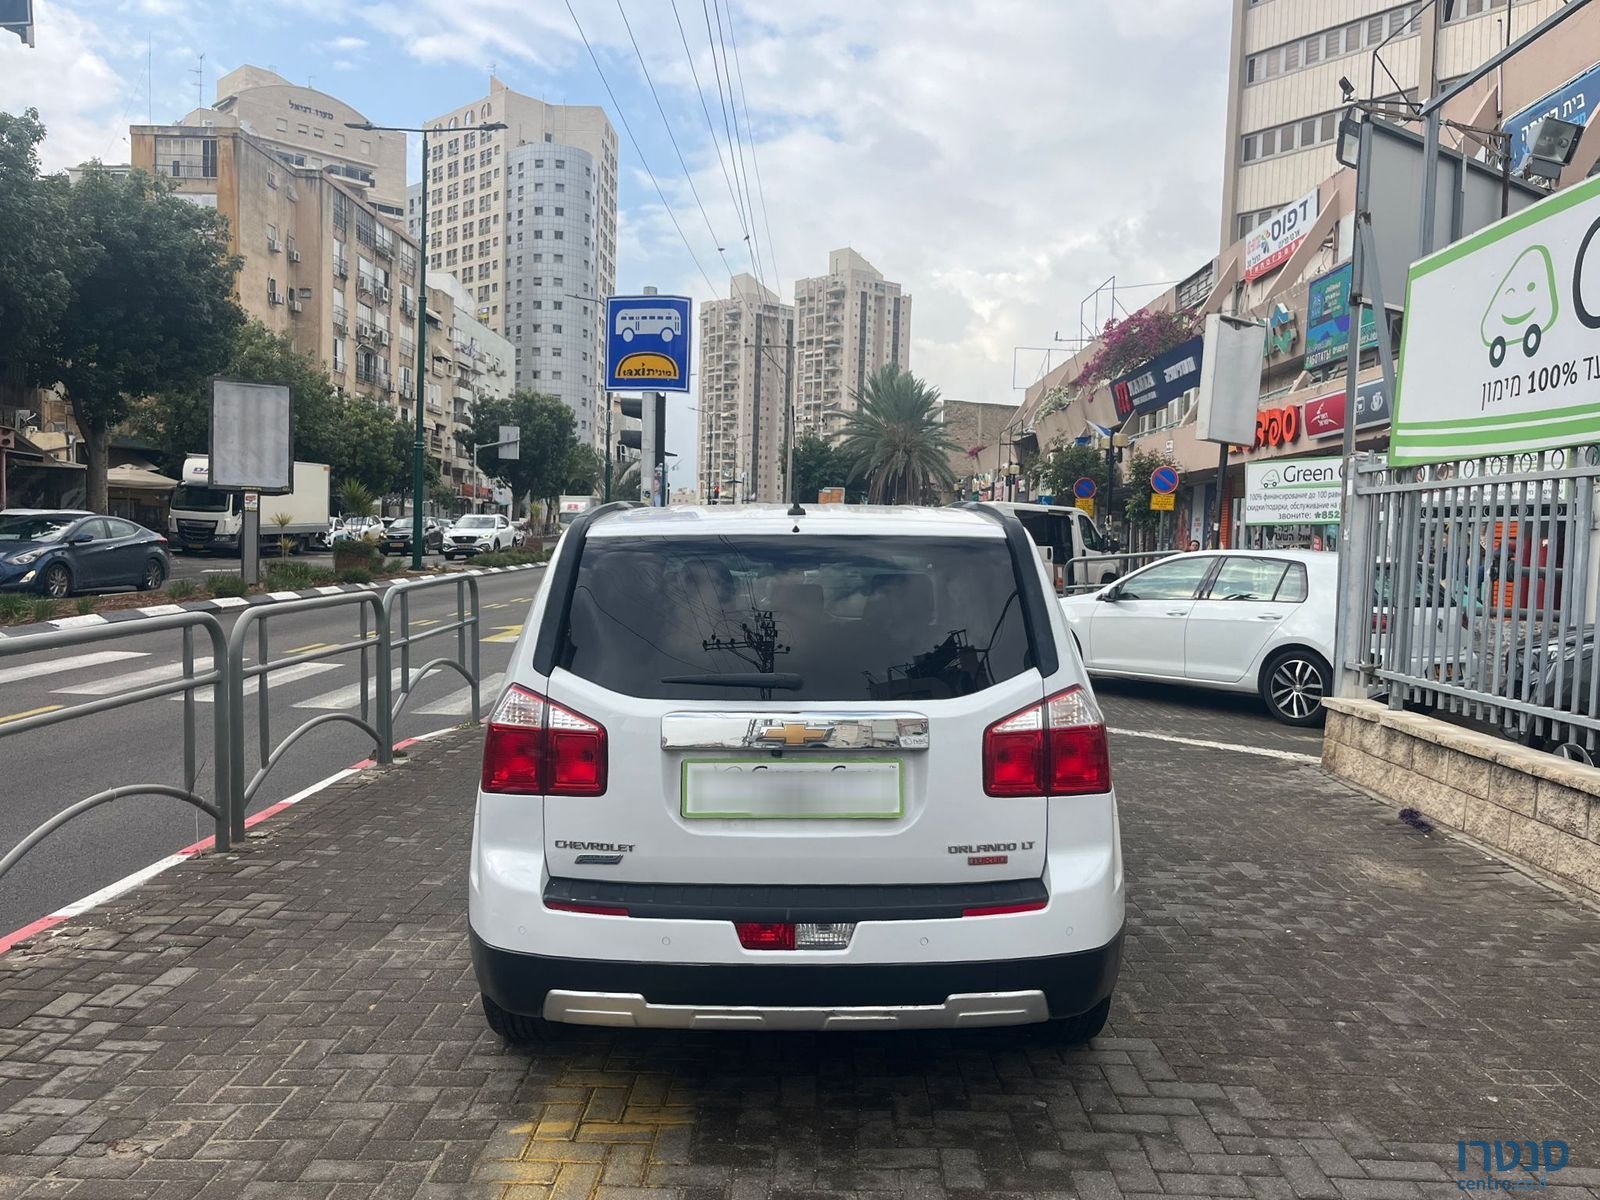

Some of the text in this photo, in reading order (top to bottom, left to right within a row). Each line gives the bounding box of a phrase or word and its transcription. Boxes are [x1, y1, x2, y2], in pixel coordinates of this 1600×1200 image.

[1563, 93, 1585, 117] בית
[1271, 199, 1308, 241] דפוס
[622, 362, 646, 376] taxi
[646, 368, 673, 377] מונית
[1527, 360, 1578, 394] 100%
[1481, 374, 1521, 411] מימון
[1283, 465, 1333, 483] Green
[555, 840, 636, 852] CHEVROLET
[948, 840, 1036, 854] ORLANDO LT
